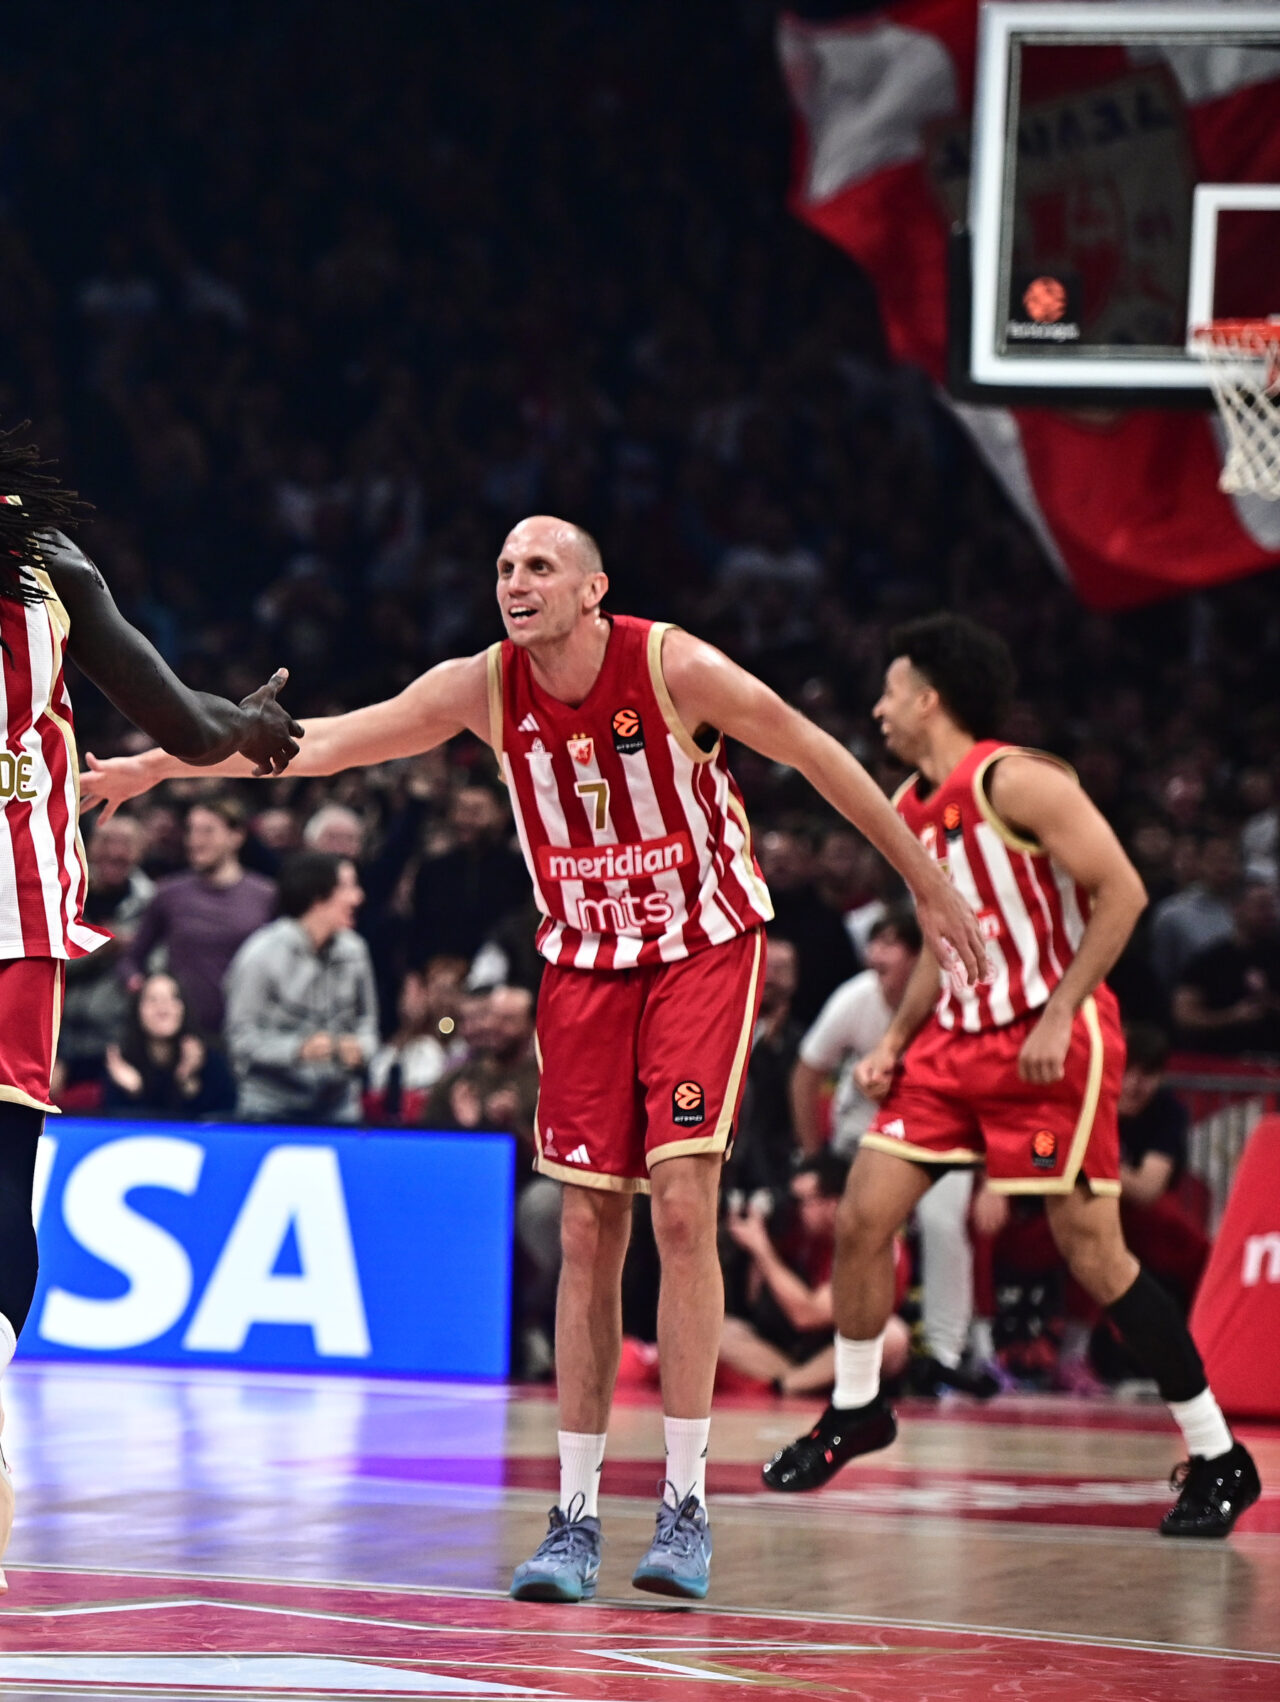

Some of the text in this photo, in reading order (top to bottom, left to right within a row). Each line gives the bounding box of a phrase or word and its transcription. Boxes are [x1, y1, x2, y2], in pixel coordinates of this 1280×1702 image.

[574, 778, 610, 832] 7
[548, 841, 684, 880] meridian
[577, 888, 674, 932] mts
